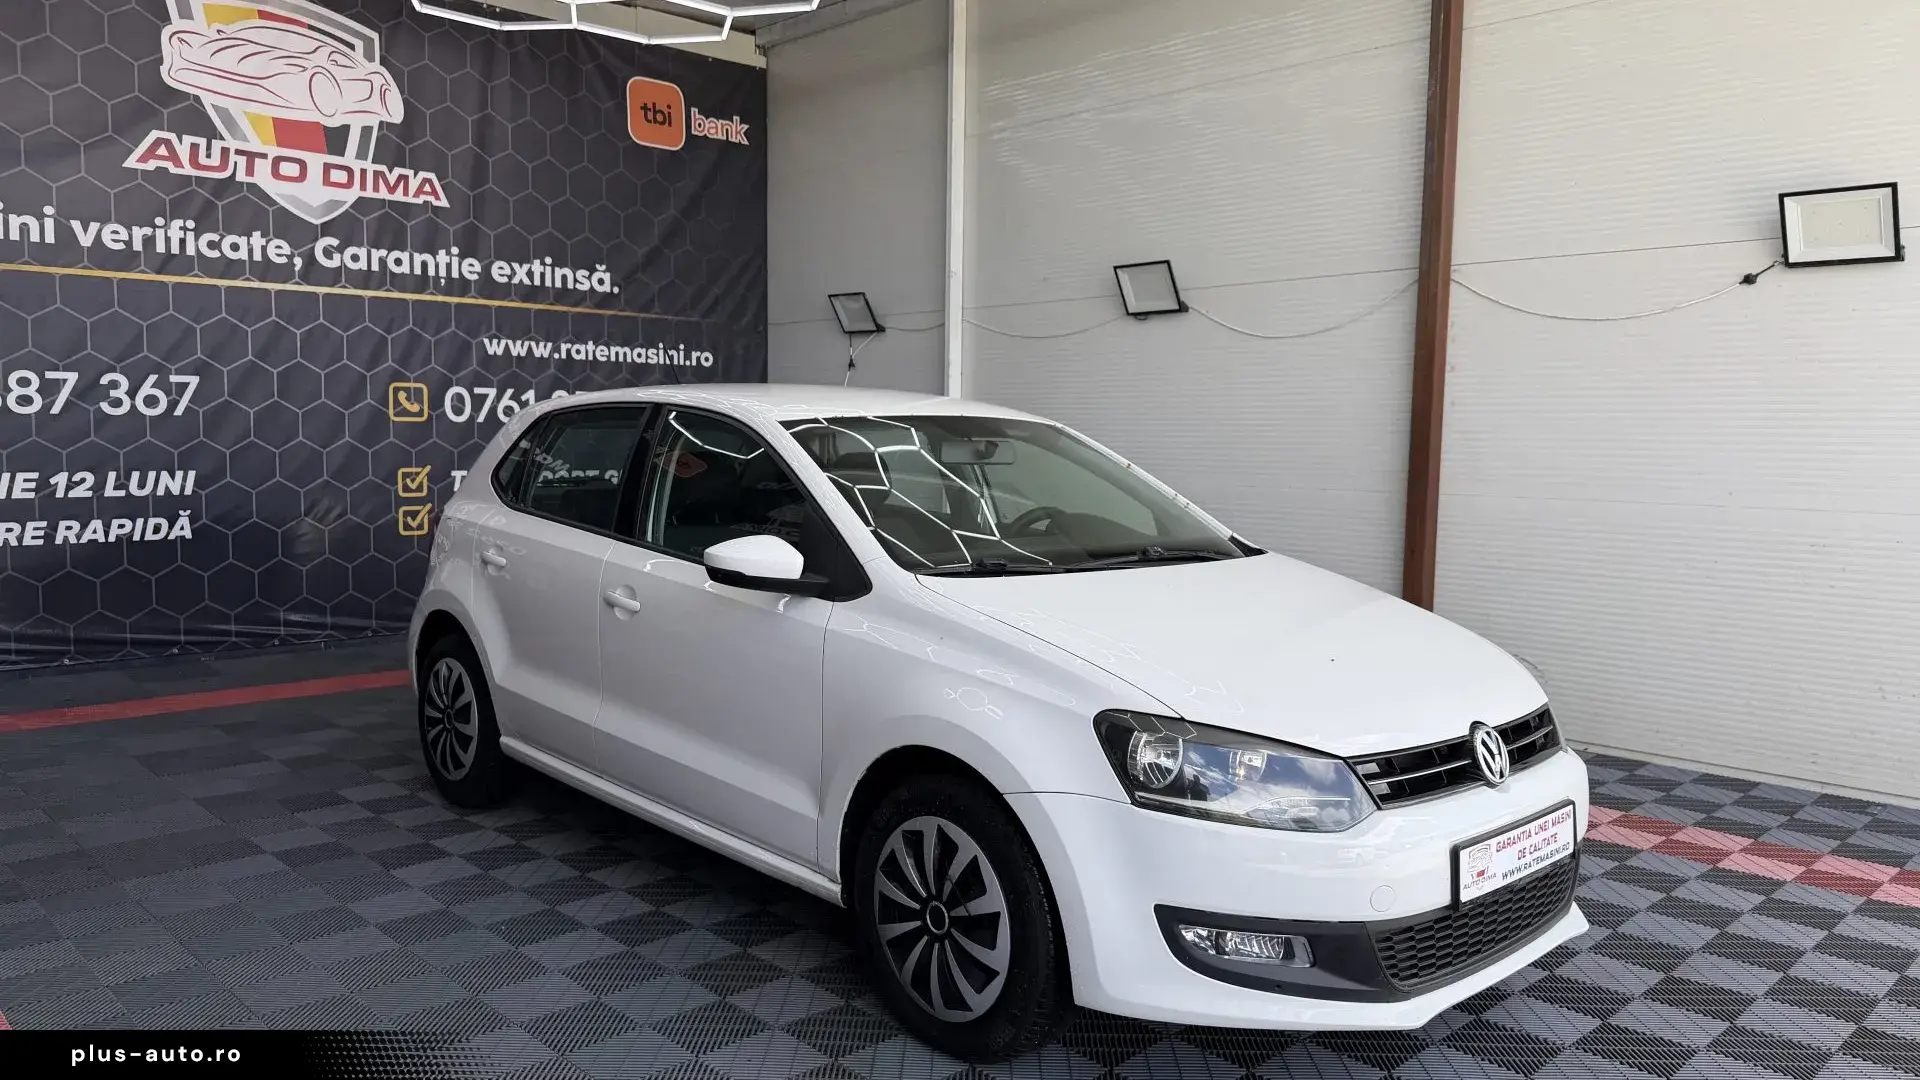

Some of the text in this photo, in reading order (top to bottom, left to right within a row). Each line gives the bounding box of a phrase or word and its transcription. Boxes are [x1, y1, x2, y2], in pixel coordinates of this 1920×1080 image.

[640, 102, 749, 145] tbi bank
[135, 136, 442, 201] AUTO DIMA
[69, 216, 303, 271] verificate,
[314, 236, 482, 286] Garanție
[491, 256, 620, 294] extinsă.
[483, 337, 714, 368] www.ratemasini.ro
[100, 372, 200, 416] 367
[49, 471, 95, 498] 12
[104, 470, 197, 497] LUNI
[55, 510, 193, 545] RAPIDĂ
[1495, 809, 1572, 853] GARANTIA UNEI MASINI
[1517, 832, 1558, 861] DE CALITATE
